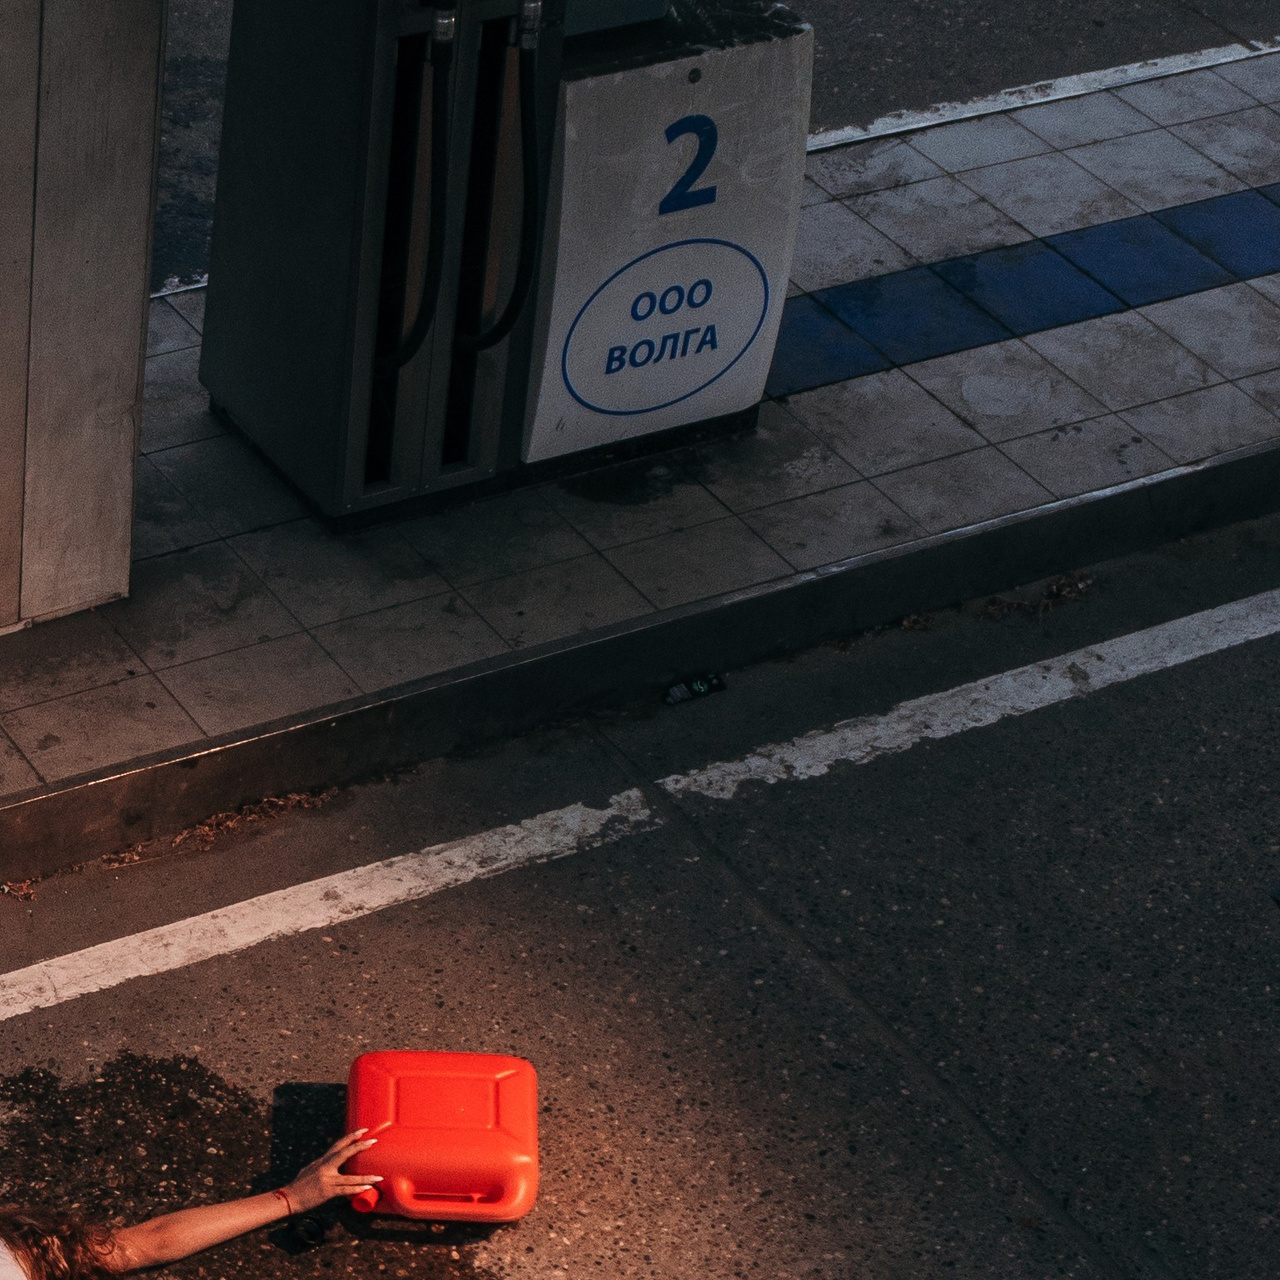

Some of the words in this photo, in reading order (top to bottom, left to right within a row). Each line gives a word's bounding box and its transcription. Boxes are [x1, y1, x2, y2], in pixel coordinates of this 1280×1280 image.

[659, 114, 718, 215] 2
[630, 278, 714, 323] ООО
[605, 324, 719, 375] ВОЛГА
